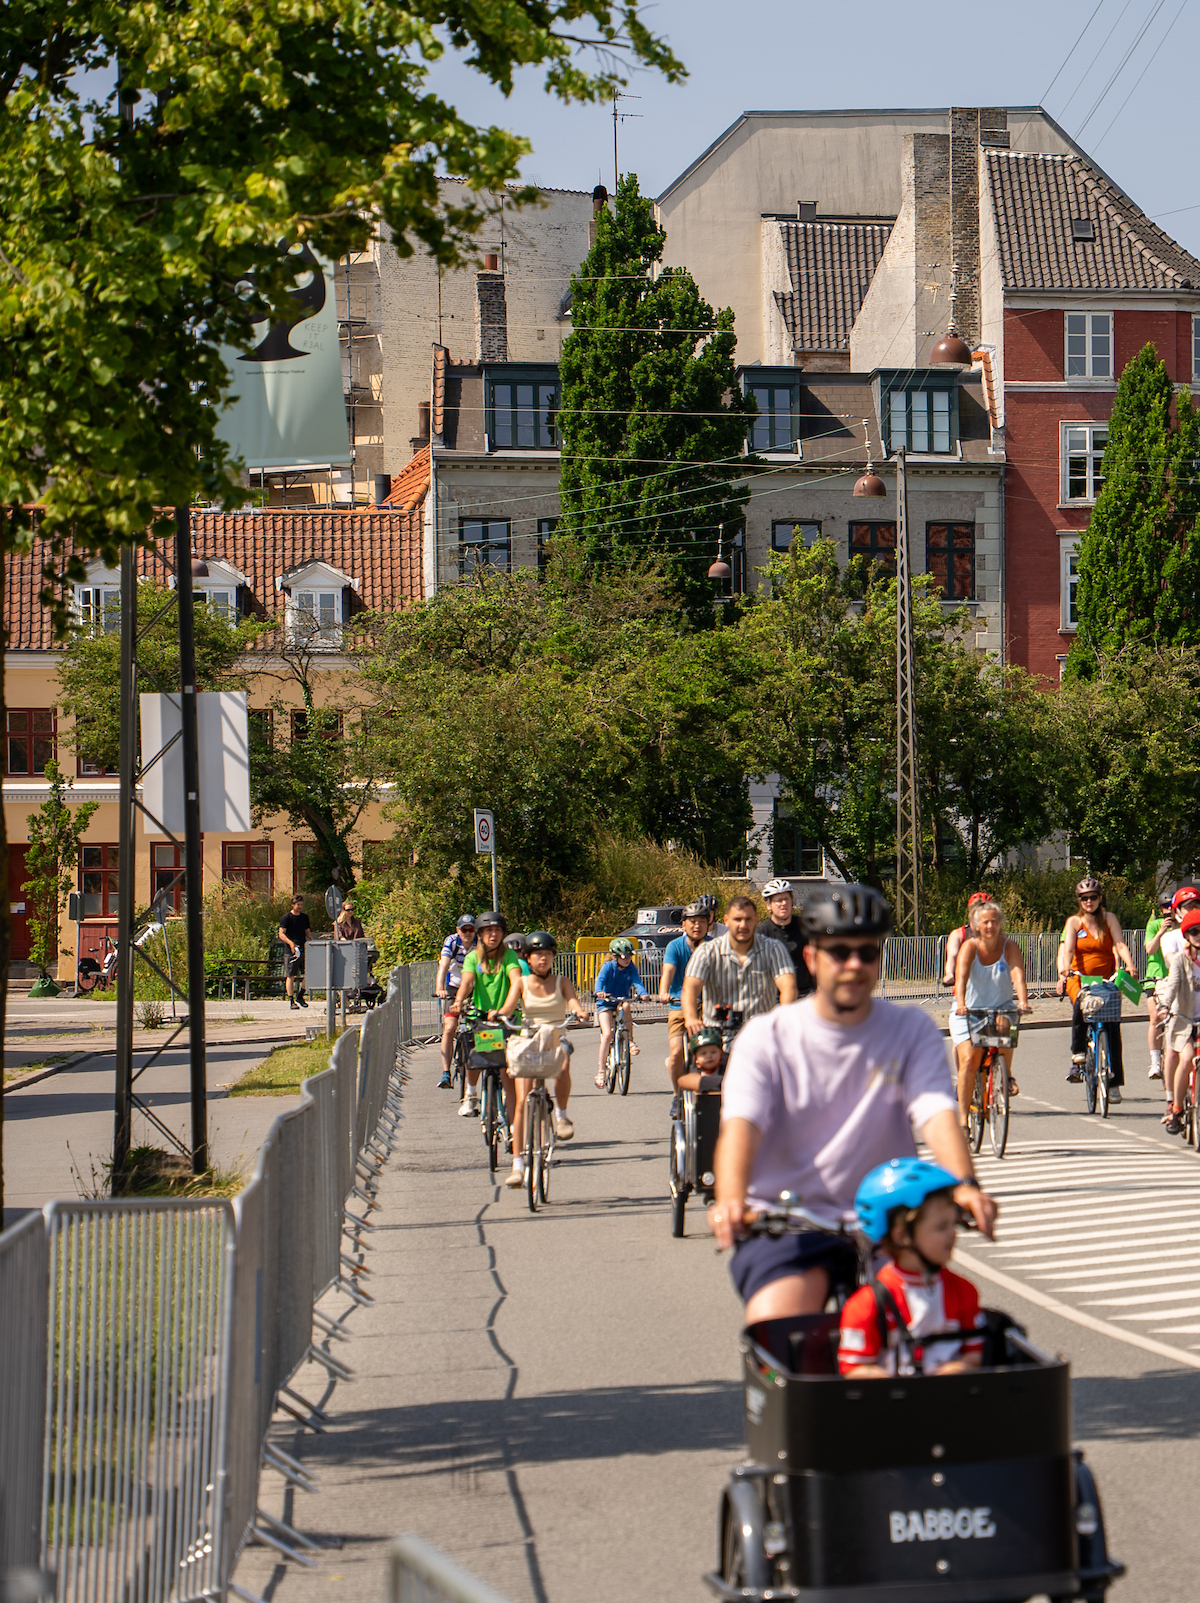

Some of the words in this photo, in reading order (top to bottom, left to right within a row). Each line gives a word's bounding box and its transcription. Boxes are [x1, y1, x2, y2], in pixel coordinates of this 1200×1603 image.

[304, 322, 329, 332] KEEP
[309, 332, 319, 340] IT
[303, 340, 325, 351] R3AL
[889, 1506, 997, 1544] BABBOE
